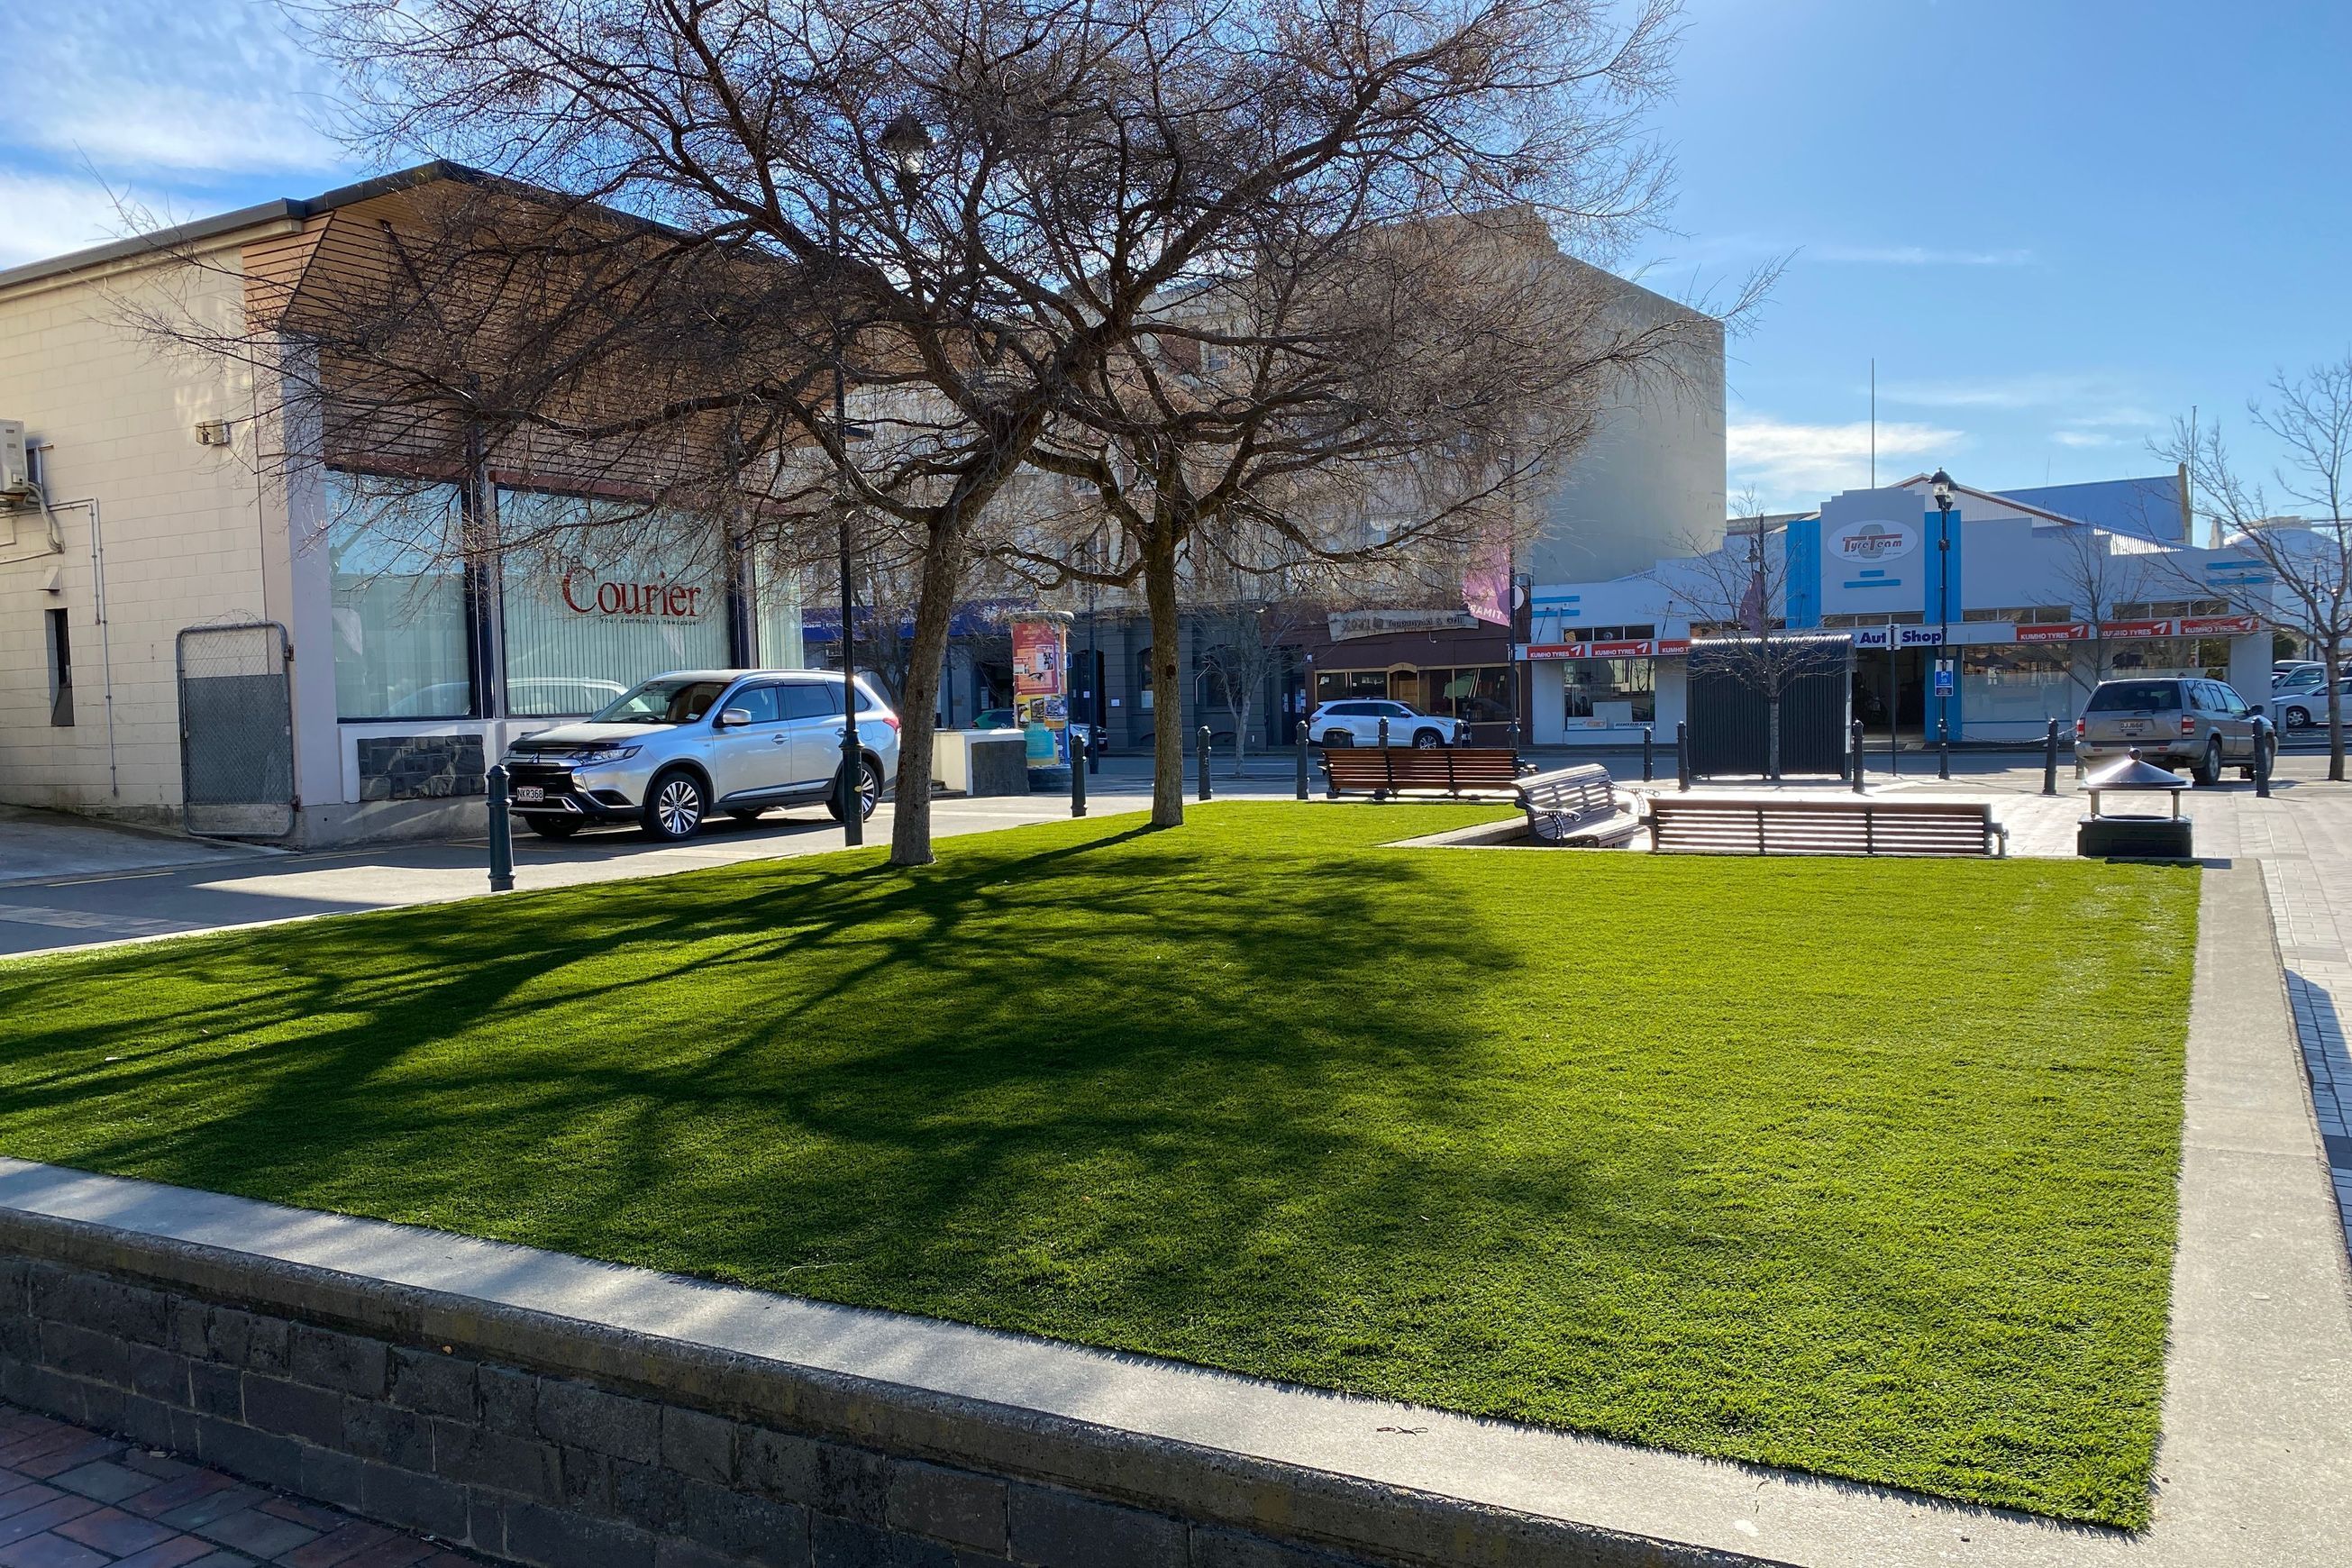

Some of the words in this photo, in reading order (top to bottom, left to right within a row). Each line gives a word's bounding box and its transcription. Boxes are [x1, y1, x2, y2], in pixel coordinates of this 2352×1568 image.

[562, 566, 701, 616] Courier
[1860, 632, 1886, 644] Aut
[1901, 630, 1942, 645] Shop
[2129, 628, 2152, 636] TYRES
[517, 789, 543, 798] NKR368
